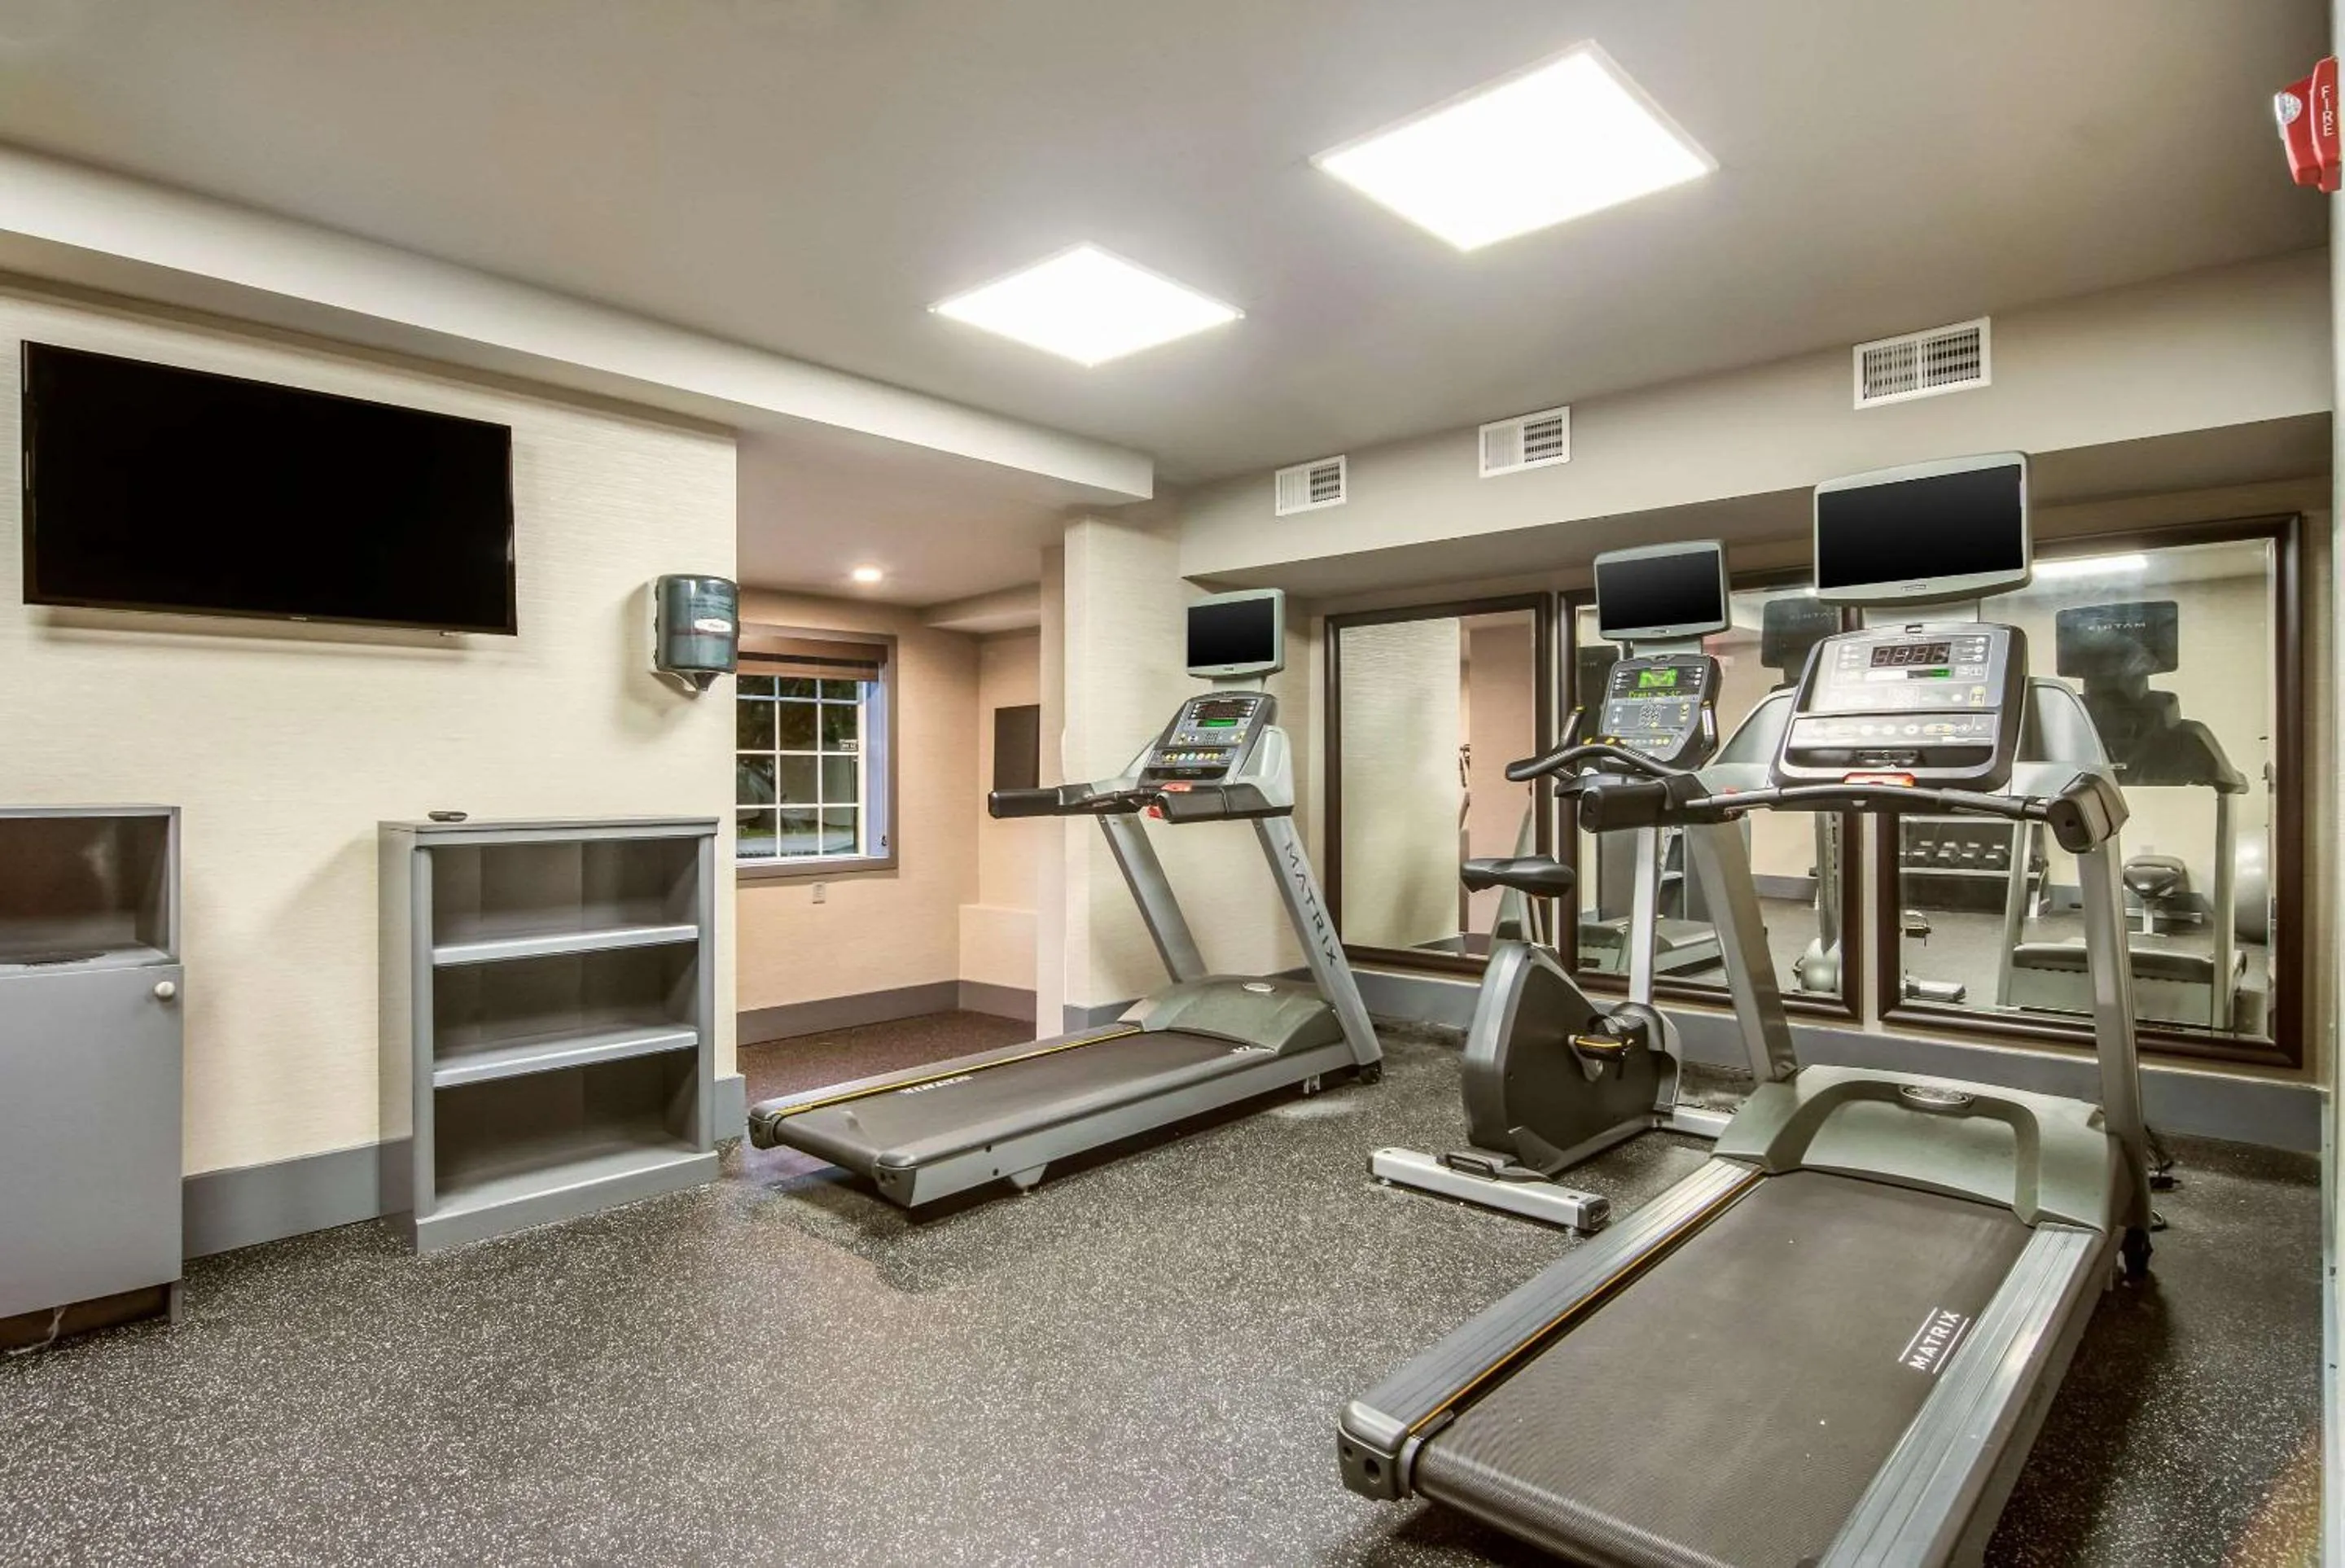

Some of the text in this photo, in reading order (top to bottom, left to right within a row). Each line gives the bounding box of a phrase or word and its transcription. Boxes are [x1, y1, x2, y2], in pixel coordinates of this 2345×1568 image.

[2321, 85, 2336, 137] FIRE
[1285, 839, 1338, 967] MATRIX
[1908, 1309, 1961, 1372] MATRIX
